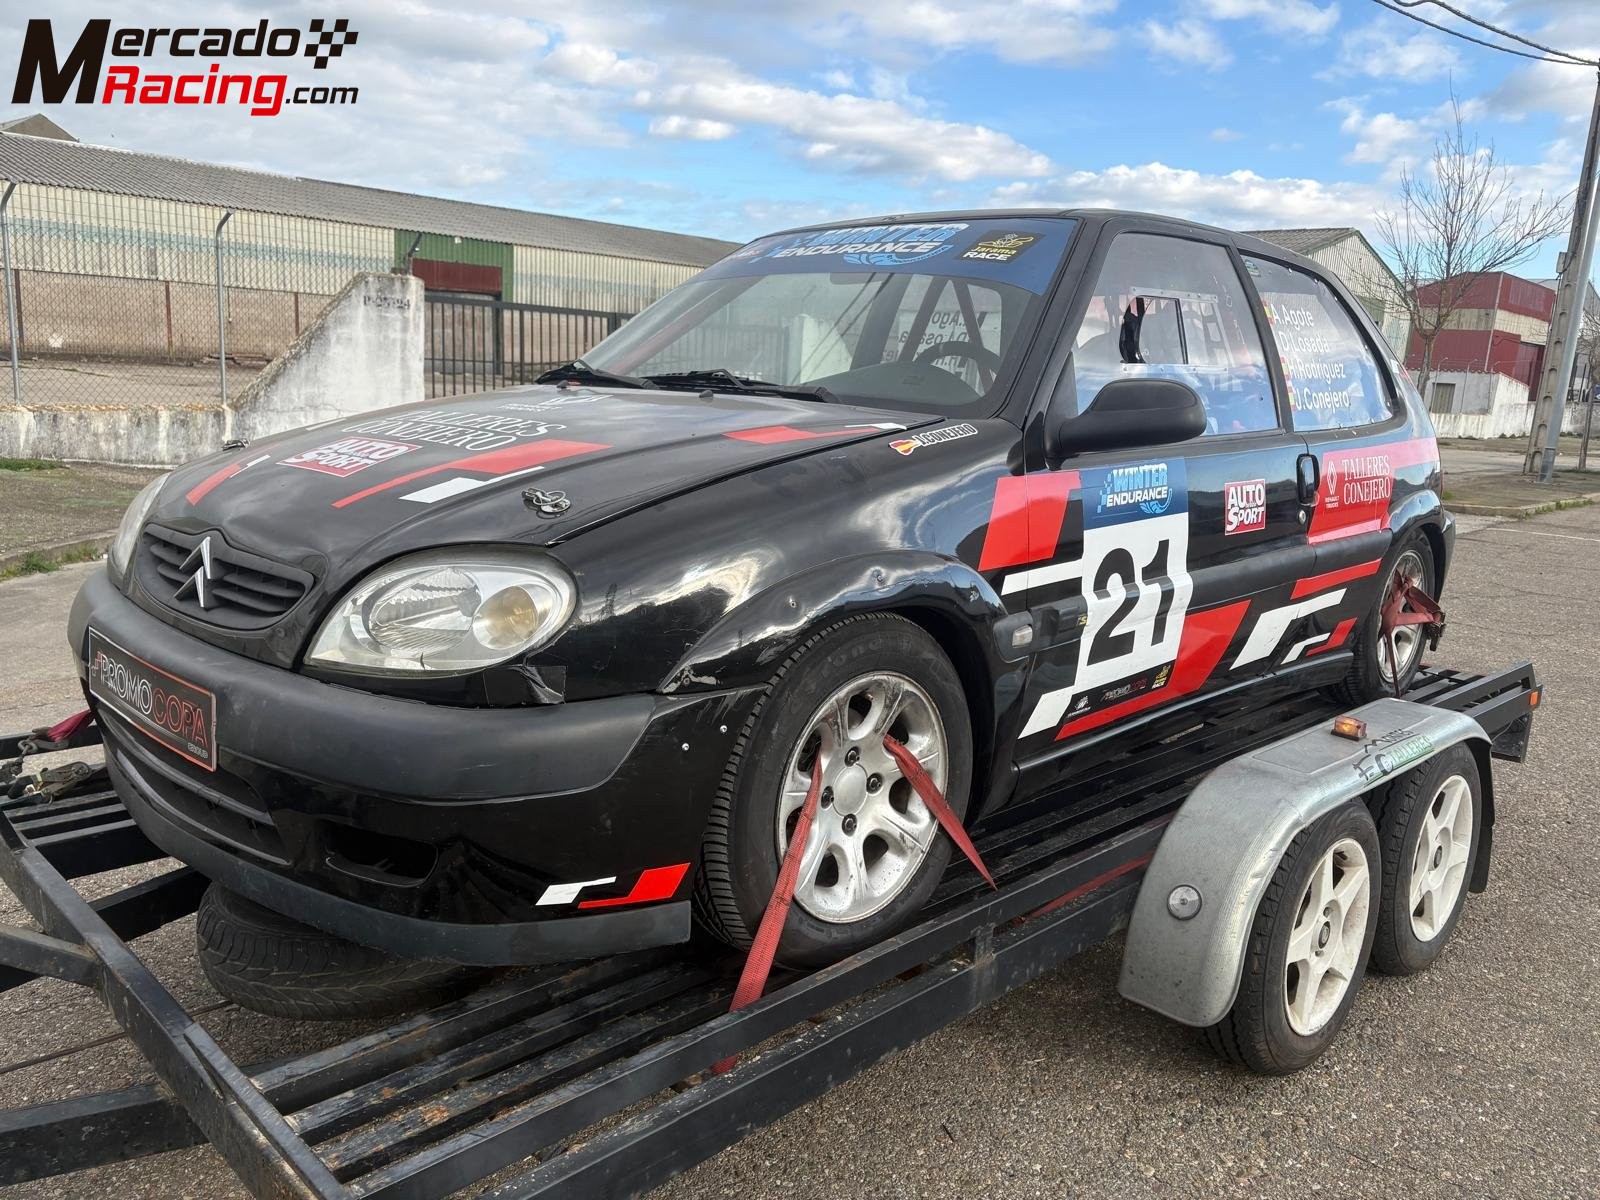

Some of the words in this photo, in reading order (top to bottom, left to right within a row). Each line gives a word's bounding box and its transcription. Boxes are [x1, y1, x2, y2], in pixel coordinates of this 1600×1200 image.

[773, 243, 940, 258] ENDURANCE
[963, 251, 1012, 261] RACE
[1271, 303, 1315, 330] A.Agote
[1295, 387, 1350, 412] J.Conejero
[341, 420, 517, 450] CONEJERO
[386, 410, 568, 437] TALLERES
[282, 449, 378, 470] SPORT
[320, 440, 409, 460] AUTO
[1112, 463, 1168, 493] WINTER
[1342, 455, 1390, 481] TALLERES
[1106, 487, 1168, 507] ENDURANCE
[1228, 484, 1264, 509] AUTO
[1343, 477, 1391, 505] CONEJERO
[1226, 506, 1264, 531] SPORT
[1086, 538, 1175, 667] 21
